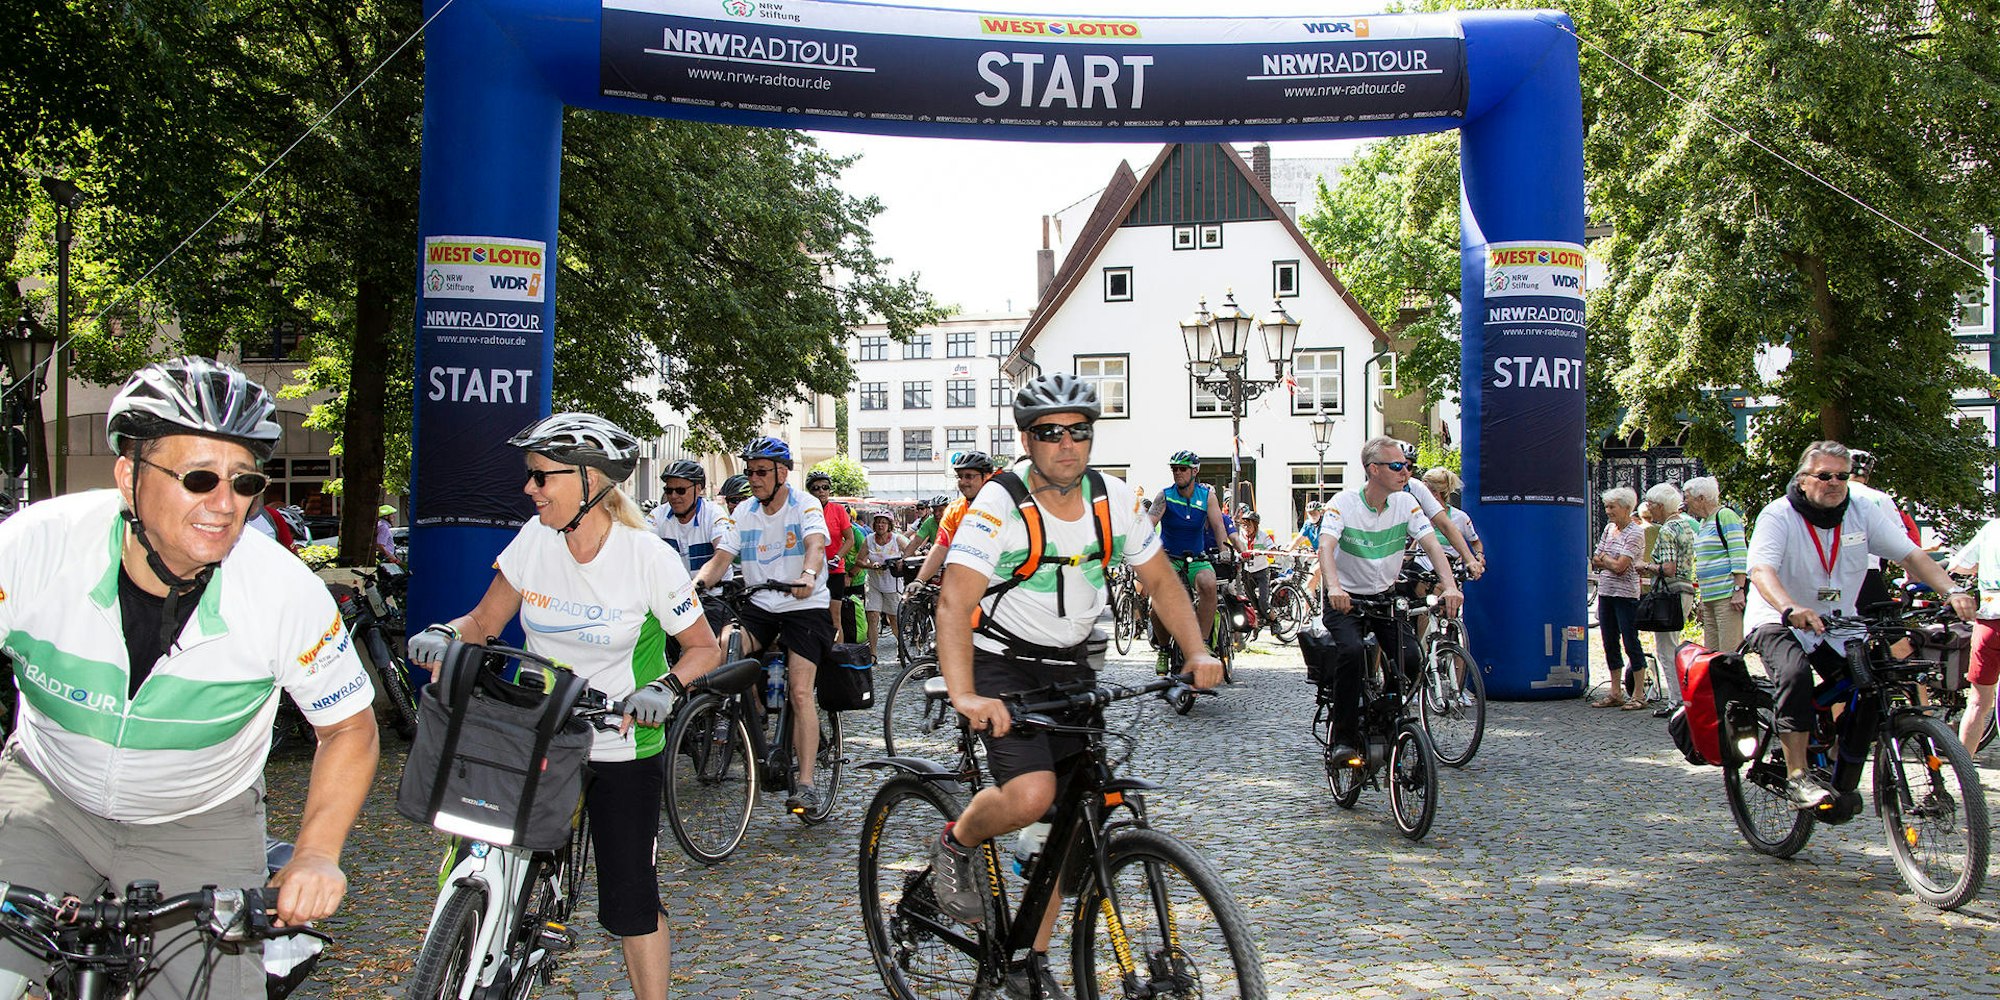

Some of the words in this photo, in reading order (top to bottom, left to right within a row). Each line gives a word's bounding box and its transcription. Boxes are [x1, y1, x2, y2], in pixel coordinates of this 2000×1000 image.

[759, 2, 783, 11] NRW
[759, 10, 801, 22] Stiftung
[983, 19, 1046, 34] WEST
[1068, 23, 1138, 37] LOTTO
[1303, 22, 1354, 34] WDR
[663, 27, 859, 67] NRWRADTOUR
[1262, 49, 1428, 75] NRWRADTOUR
[687, 66, 832, 90] www.nrw-radtour.de
[974, 50, 1154, 109] START
[1284, 81, 1406, 97] www.nrw-radtour.de
[429, 246, 472, 263] WEST
[489, 248, 541, 266] LOTTO
[1492, 250, 1537, 265] WEST
[1551, 251, 1584, 269] LOTTO
[446, 274, 463, 282] NRW
[489, 275, 528, 290] WDR
[1552, 274, 1579, 289] WDR
[446, 282, 475, 293] Stiftung
[1511, 282, 1539, 290] Stiftung
[426, 310, 540, 330] NRWRADTOUR
[436, 334, 527, 346] www.nrw-radtour.de
[1502, 327, 1578, 339] www.nrw-radtour.de
[954, 363, 968, 372] dm
[1492, 356, 1582, 390] START
[428, 365, 533, 404] START
[577, 631, 611, 645] 2013
